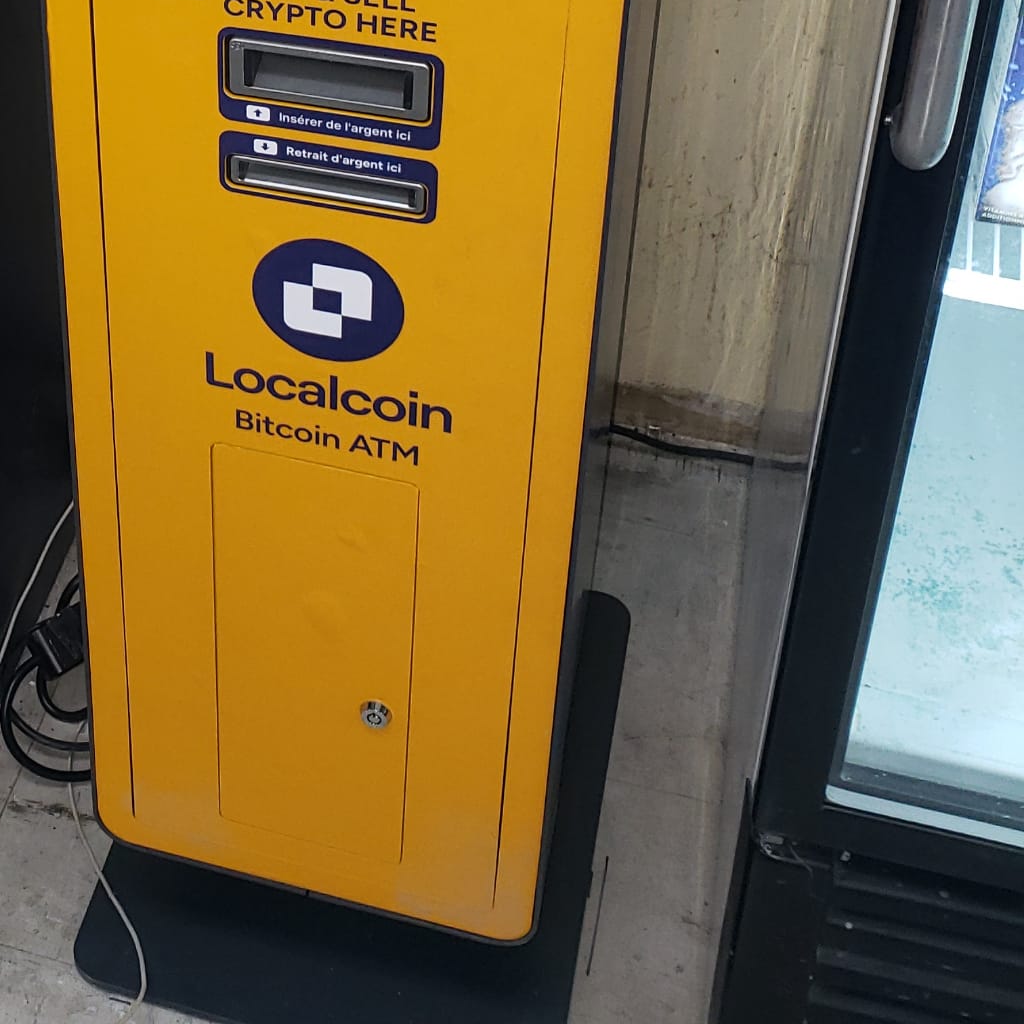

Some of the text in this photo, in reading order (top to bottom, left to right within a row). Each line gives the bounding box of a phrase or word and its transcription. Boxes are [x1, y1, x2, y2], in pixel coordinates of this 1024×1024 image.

[357, 12, 438, 43] HERE
[279, 111, 411, 142] Insérer de l'argent ici
[286, 146, 402, 174] Retrait d'argent ici
[205, 351, 453, 434] Localcoin
[235, 409, 419, 466] Bitcoin ATM
